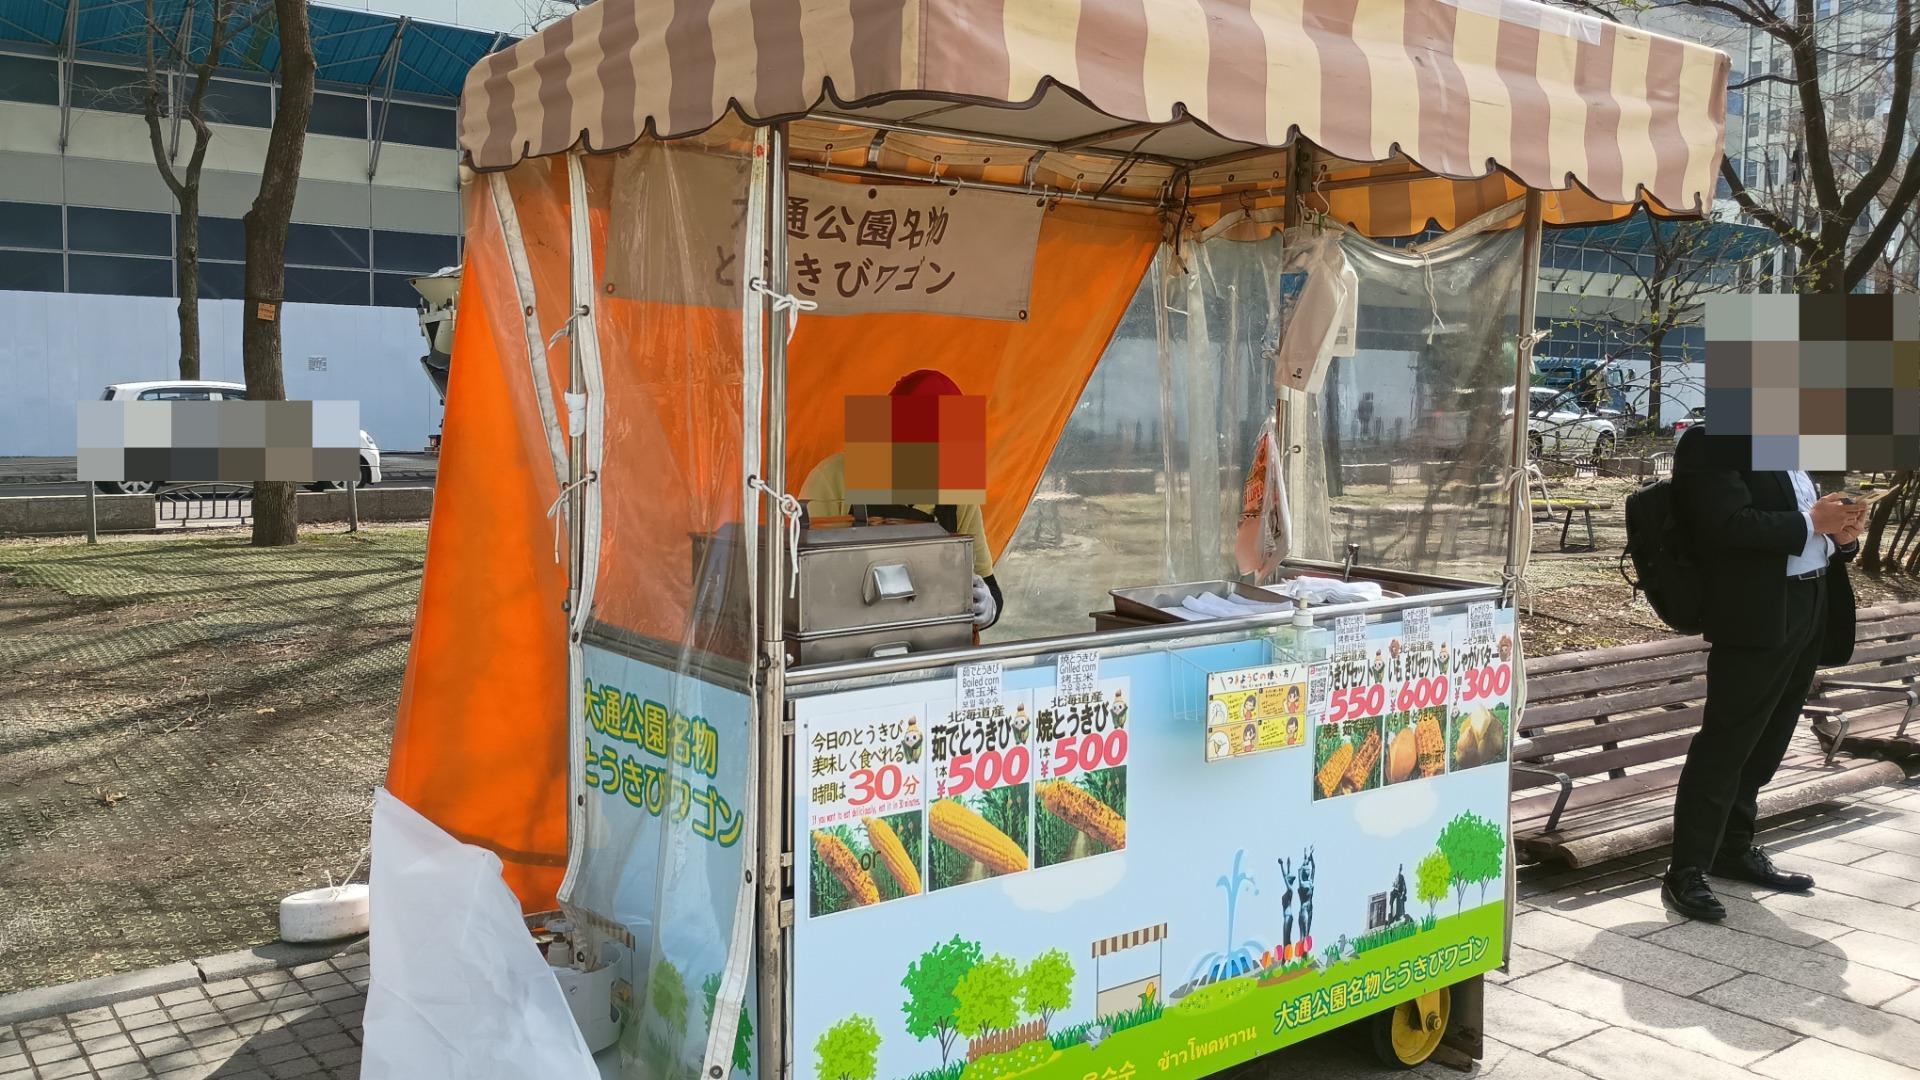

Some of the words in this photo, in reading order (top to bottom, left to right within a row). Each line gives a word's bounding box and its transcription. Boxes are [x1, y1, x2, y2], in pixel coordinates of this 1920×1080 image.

[716, 245, 956, 297] ときびワゴン
[962, 677, 983, 688] Boiled
[984, 675, 1000, 686] corn
[1060, 664, 1081, 674] Grilled
[1082, 662, 1097, 672] corn
[947, 704, 1006, 724] 北海道産
[1051, 691, 1104, 709] 北海道産
[583, 677, 718, 780] 大通公園名物
[811, 719, 904, 753] 今日のとうきび
[930, 714, 1012, 763] 茹でとうきび
[1036, 701, 1110, 743] 焼とうきび
[812, 743, 905, 778] 美味しく食べれる
[584, 736, 744, 848] とうきびワゴン
[860, 850, 882, 872] or
[1274, 935, 1490, 1035] 大通公園名物とうきびワゴン
[1157, 1025, 1257, 1071] ข้าวโพดหวาน
